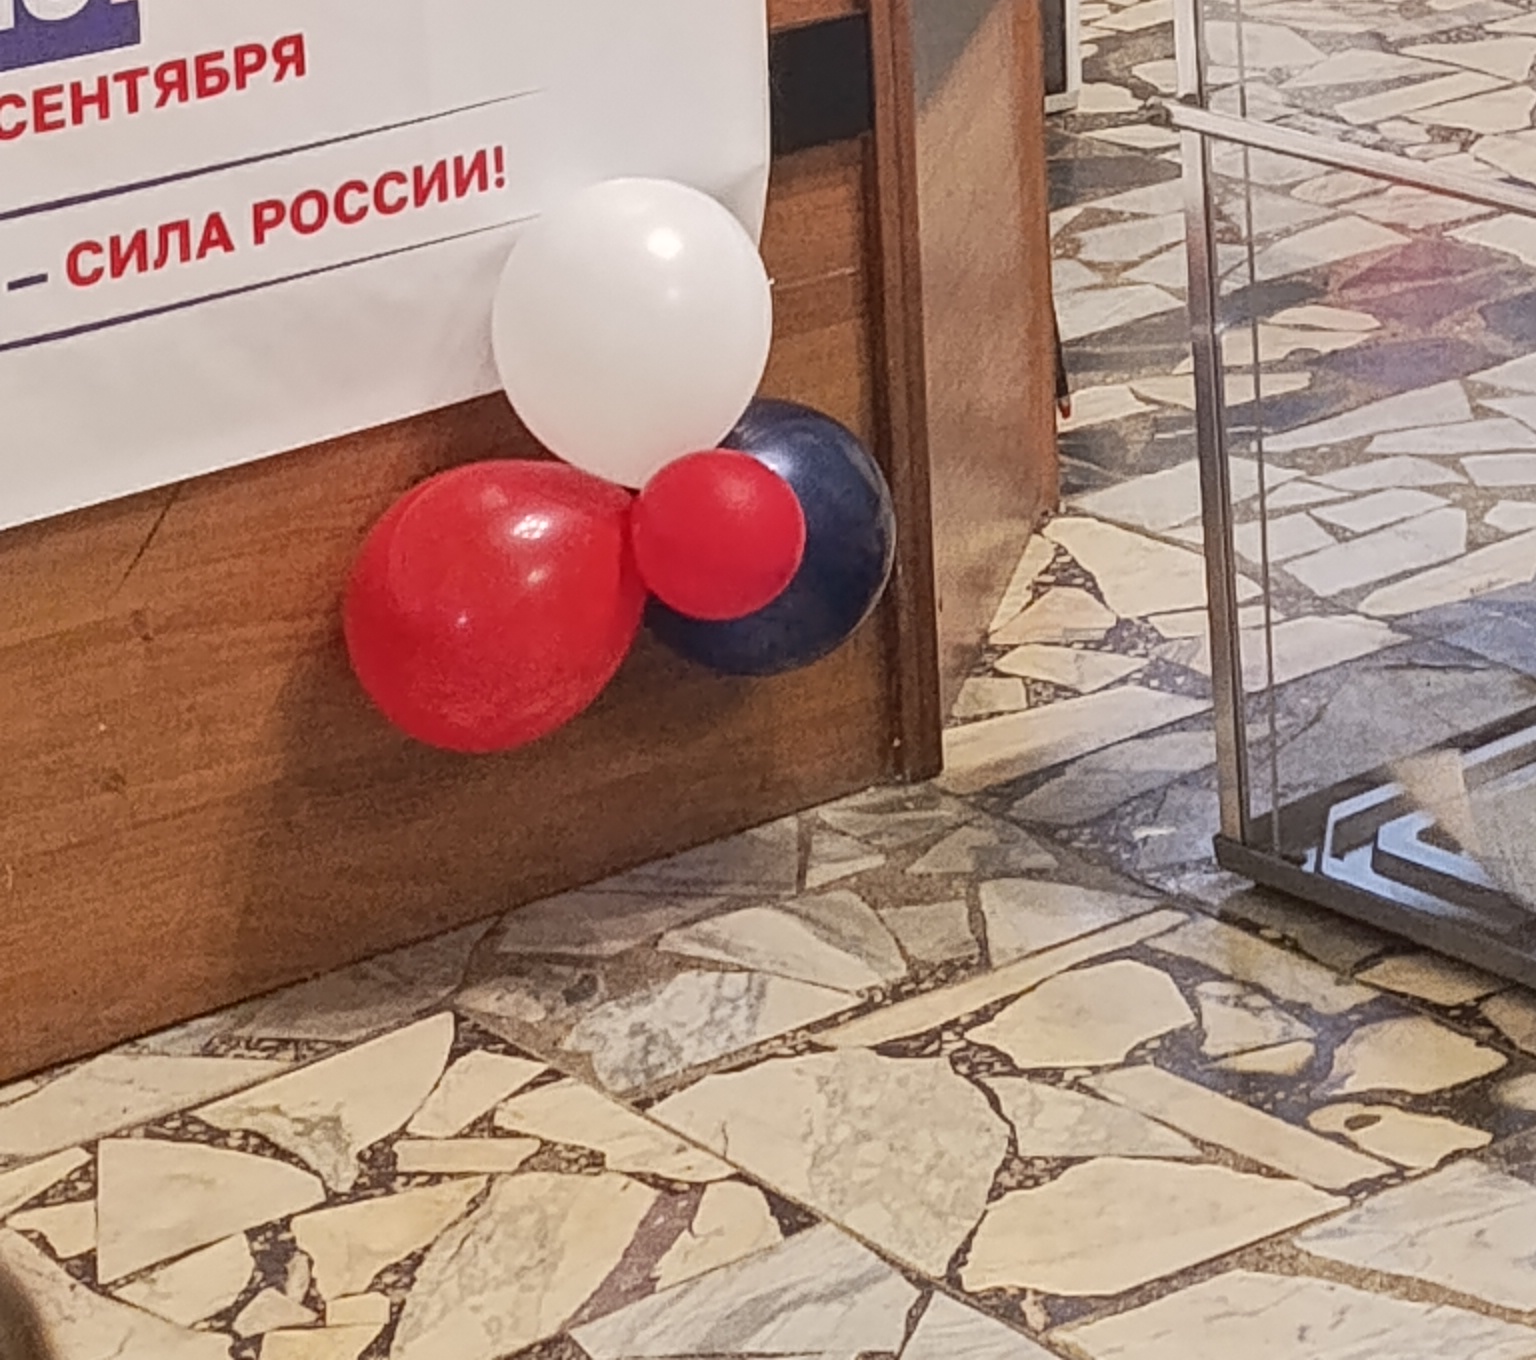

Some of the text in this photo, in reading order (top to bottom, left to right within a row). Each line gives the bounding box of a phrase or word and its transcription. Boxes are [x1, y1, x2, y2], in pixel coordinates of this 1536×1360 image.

[0, 32, 307, 141] СЕНТЯБРЯ
[65, 211, 235, 287] СИЛА
[252, 145, 506, 246] РОССИИ!
